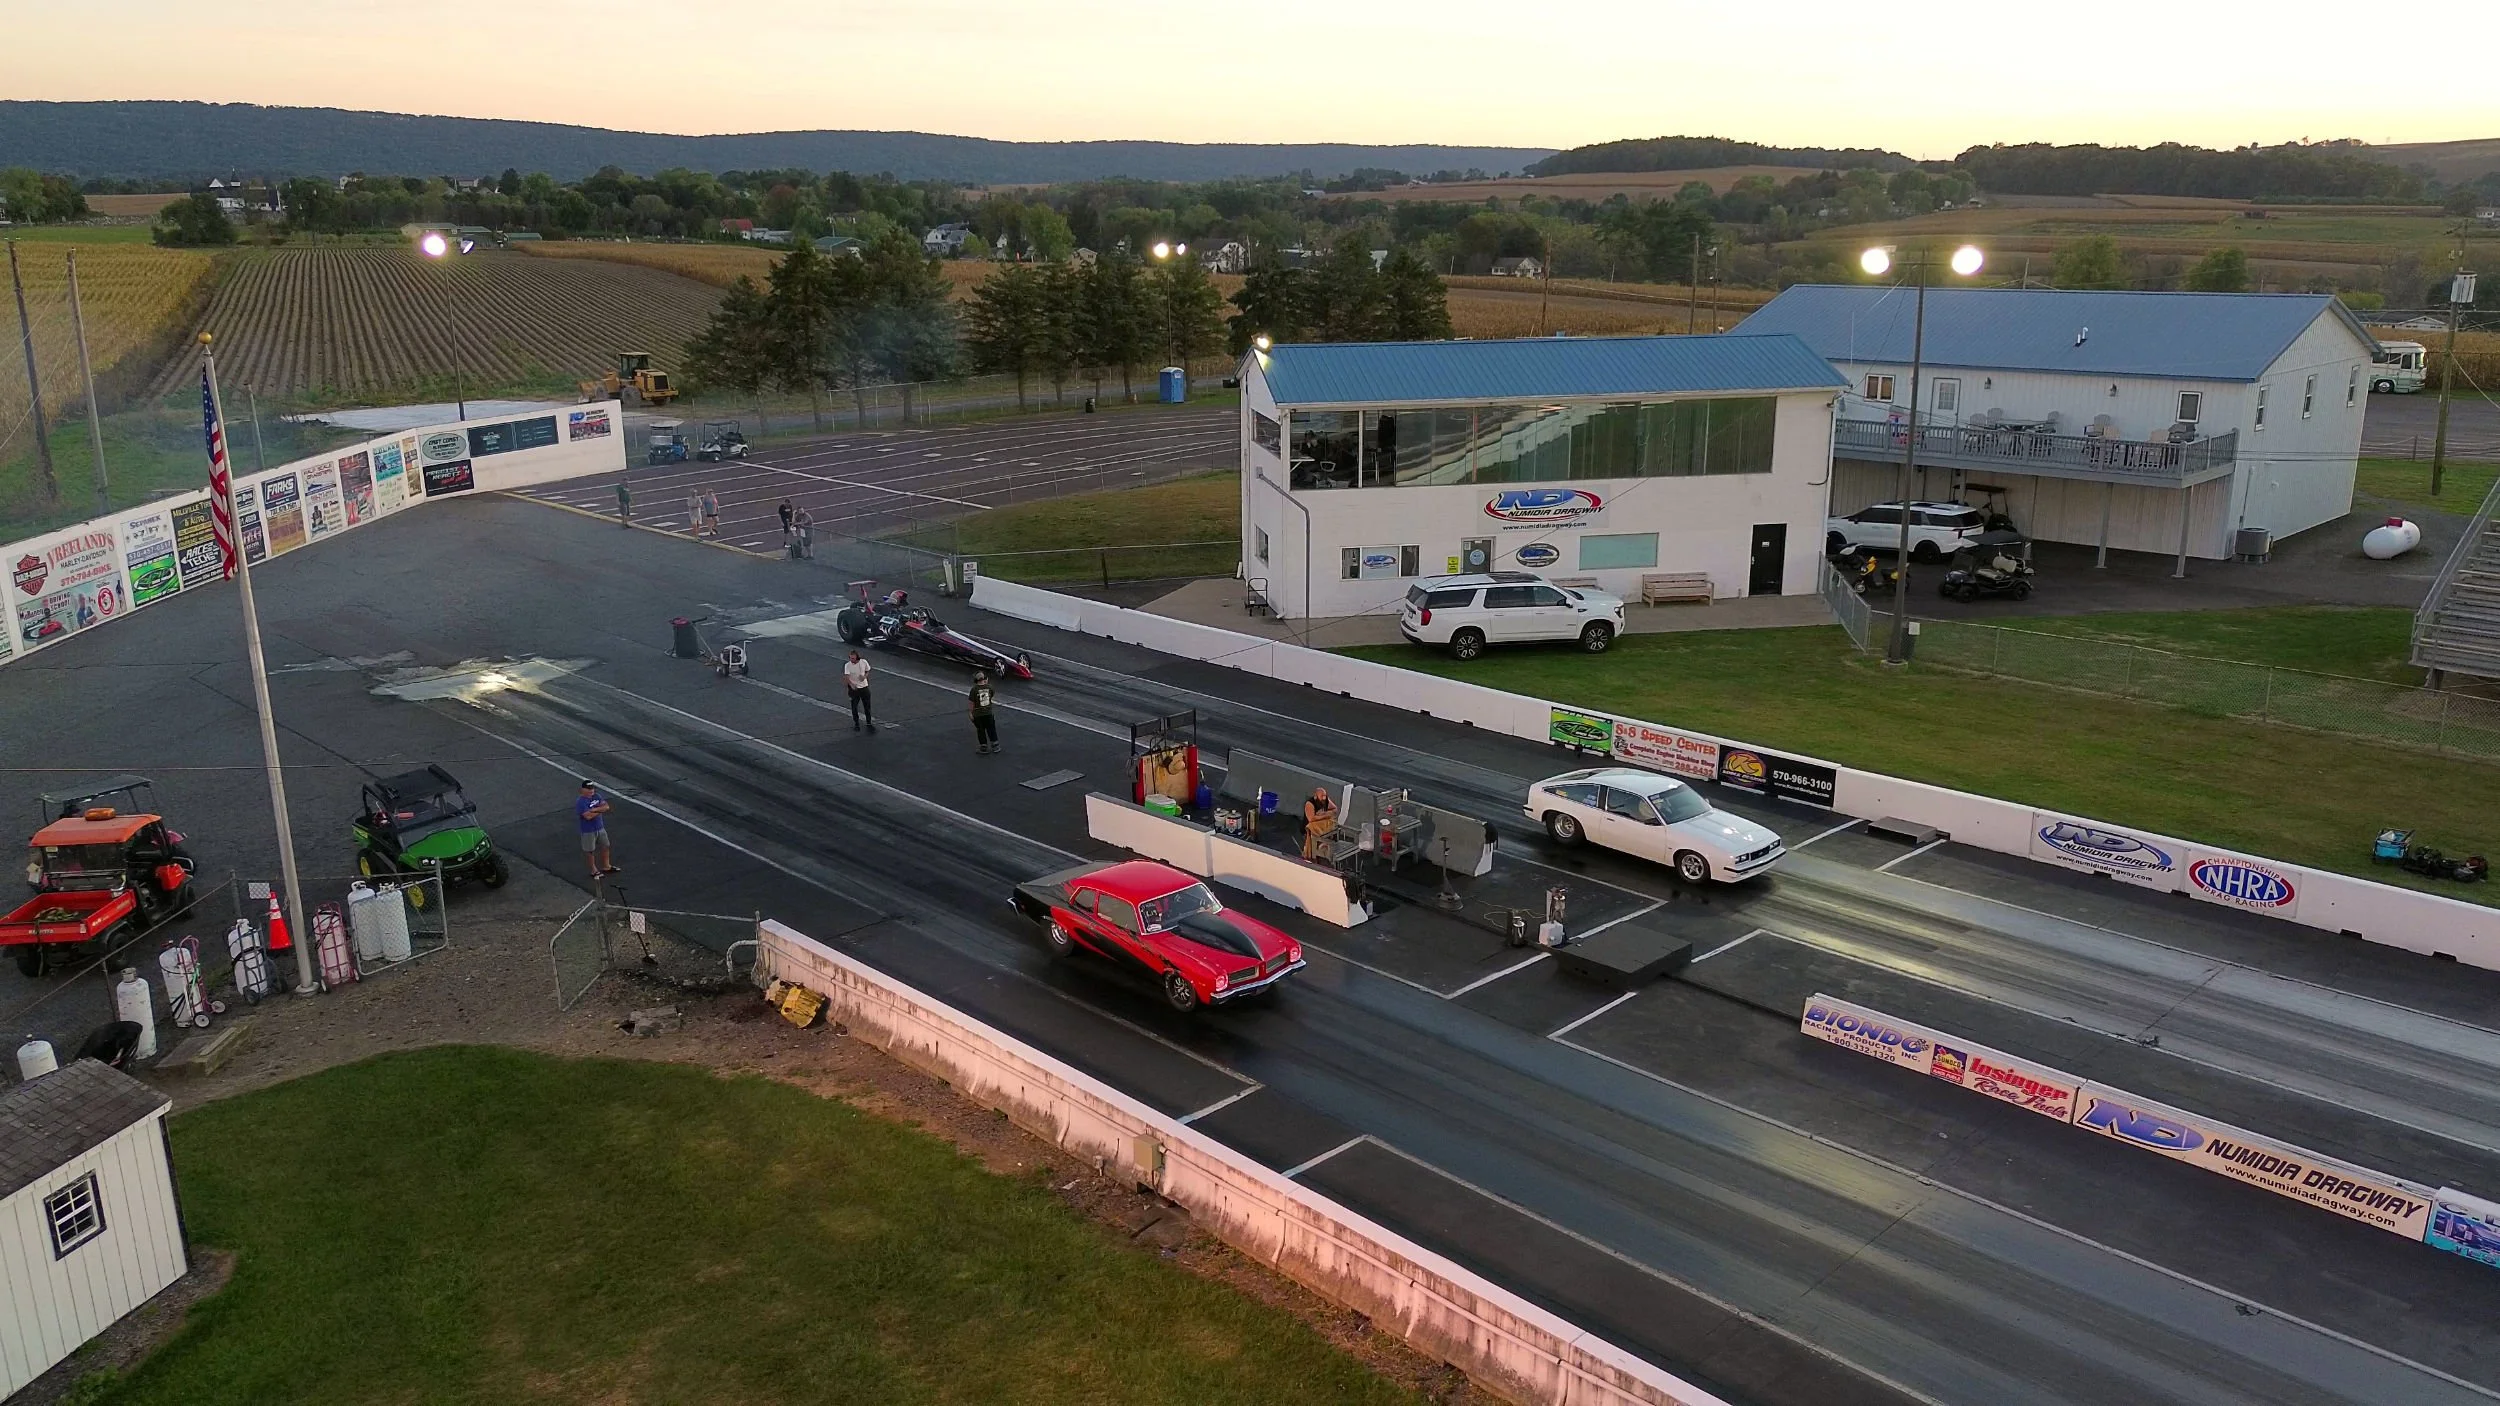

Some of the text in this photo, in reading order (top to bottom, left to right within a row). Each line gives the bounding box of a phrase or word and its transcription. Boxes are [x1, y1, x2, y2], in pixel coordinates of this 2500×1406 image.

[172, 504, 200, 518] MILLVILLE
[190, 516, 204, 525] AUTO
[1507, 506, 1606, 518] NUMIDIA DRAGWAY
[1502, 521, 1587, 531] www.numidiadragway.com
[47, 531, 115, 570] VREELAND'S
[1629, 743, 1655, 755] Complete
[1656, 748, 1676, 759] Engine
[1676, 754, 1699, 763] Machine
[1701, 760, 1716, 769] Shop
[1640, 728, 1673, 745] SPEED
[1676, 737, 1716, 756] CENTER
[1773, 770, 1833, 791] 570-966-3100
[2048, 821, 2143, 853] ND
[2056, 853, 2153, 882] www.numidiadragway.com
[2063, 842, 2176, 874] NUMIDIA DRAGWAY
[2207, 857, 2281, 880] CHAMPIONSHIP
[2203, 886, 2275, 909] DRAG RACING
[2204, 866, 2279, 901] NHRA
[1804, 1004, 1924, 1054] BIONDO
[1804, 1019, 1838, 1035] RACING
[1901, 1051, 1921, 1062] INC.
[1826, 1034, 1896, 1062] 1-800-332-1320
[1936, 1054, 1962, 1069] SUNOCO
[1968, 1057, 2070, 1100] Insinger
[1974, 1077, 2069, 1119] Race Fuels
[2075, 1097, 2204, 1152] ND
[2205, 1138, 2302, 1180] NUMIDIA
[2301, 1169, 2425, 1220] DRAGWAY
[2224, 1164, 2397, 1229] www.numidiadragway.com
